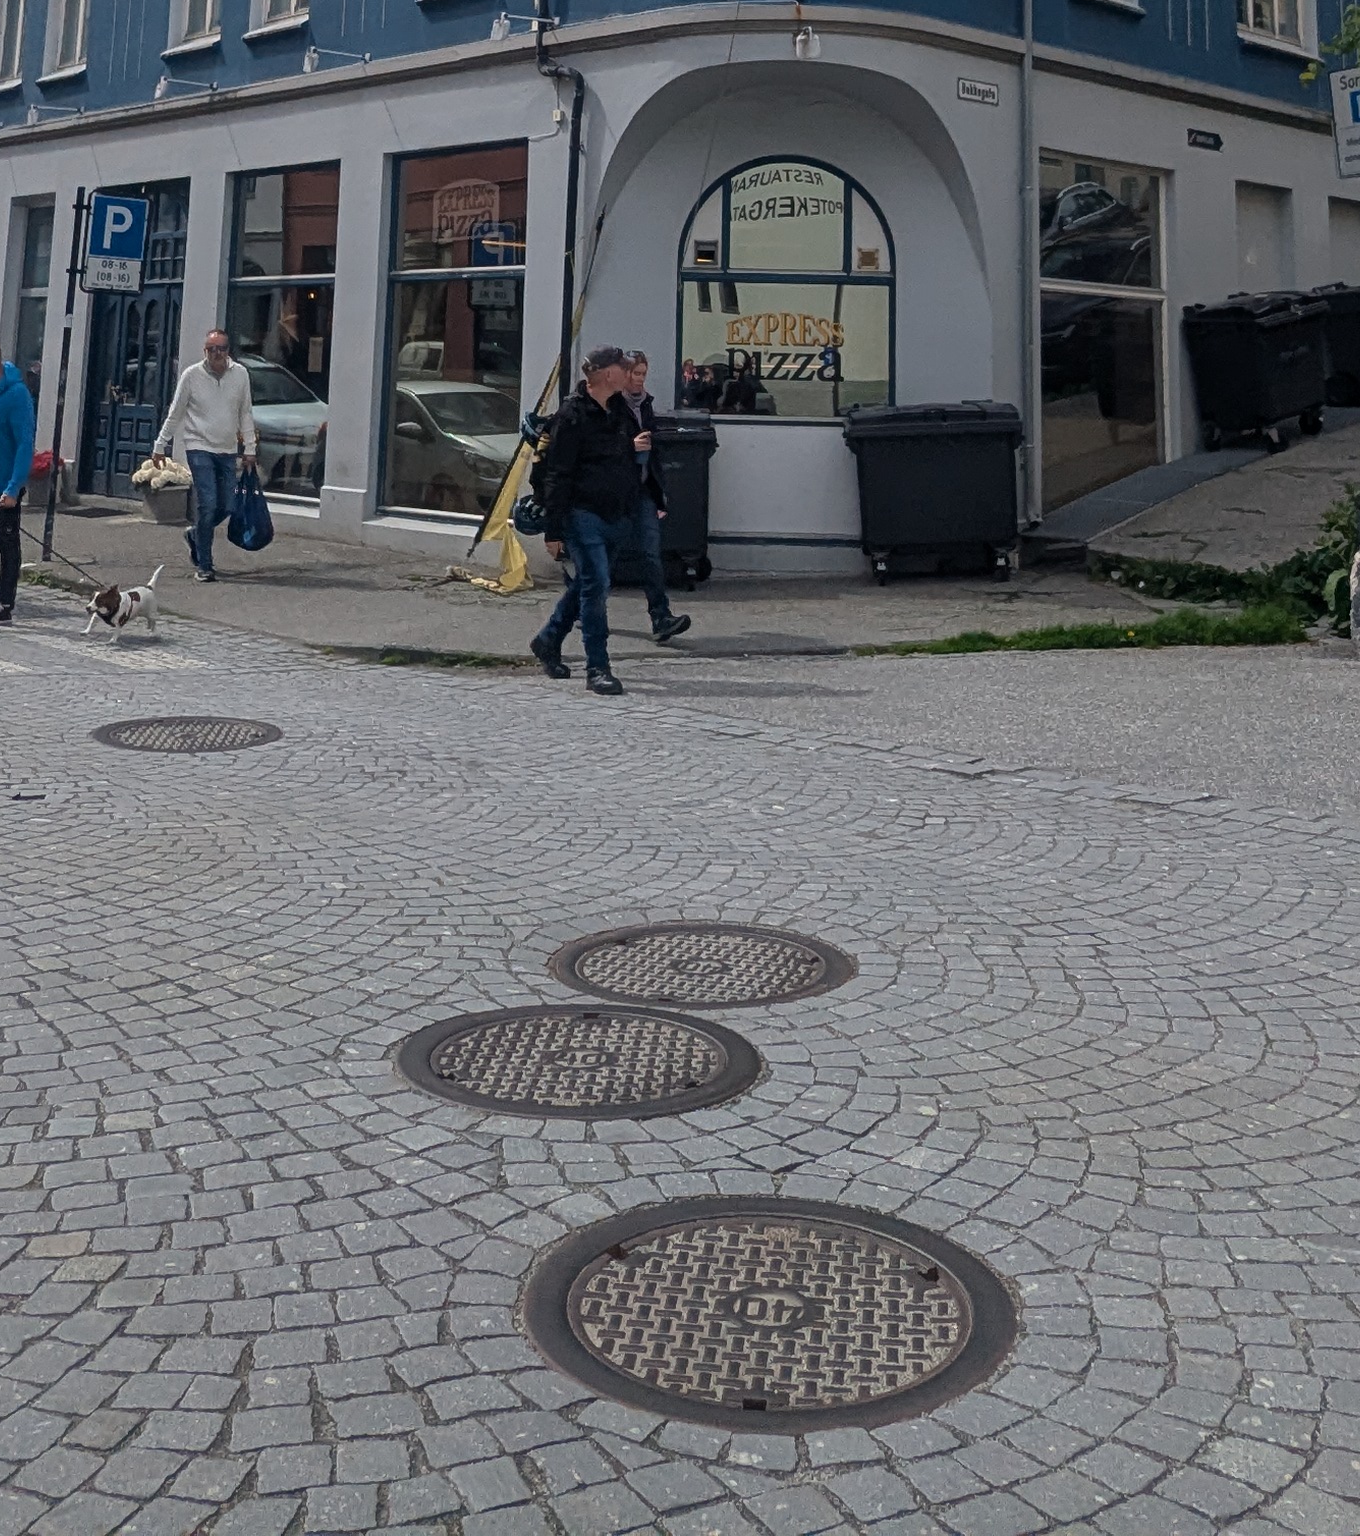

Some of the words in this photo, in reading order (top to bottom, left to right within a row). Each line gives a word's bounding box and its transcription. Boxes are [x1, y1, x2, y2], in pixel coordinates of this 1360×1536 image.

[102, 205, 133, 250] P
[101, 260, 128, 270] 08-16
[726, 312, 844, 348] EXPRESS
[725, 347, 845, 382] pizza
